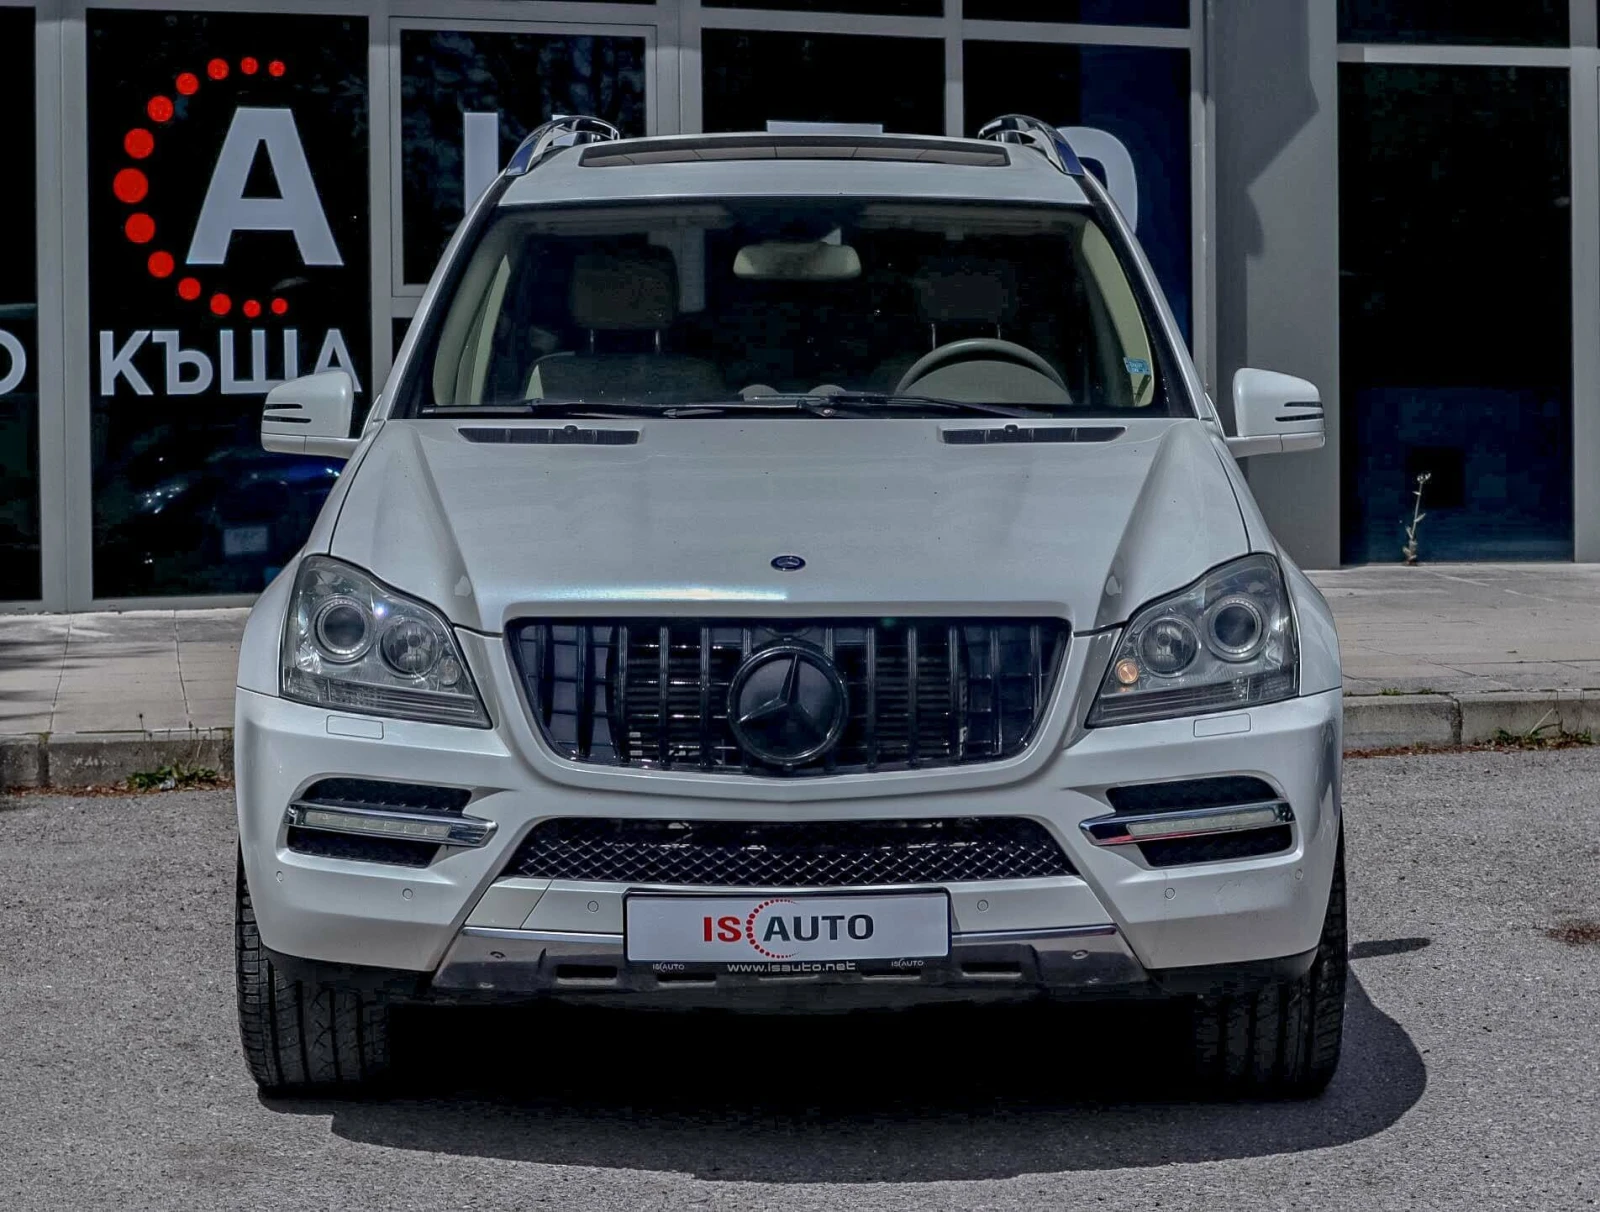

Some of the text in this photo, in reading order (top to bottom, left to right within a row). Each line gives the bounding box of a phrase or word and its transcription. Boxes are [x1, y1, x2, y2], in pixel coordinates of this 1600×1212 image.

[703, 914, 874, 942] IS AUTO
[727, 961, 856, 972] www.isauto.net
